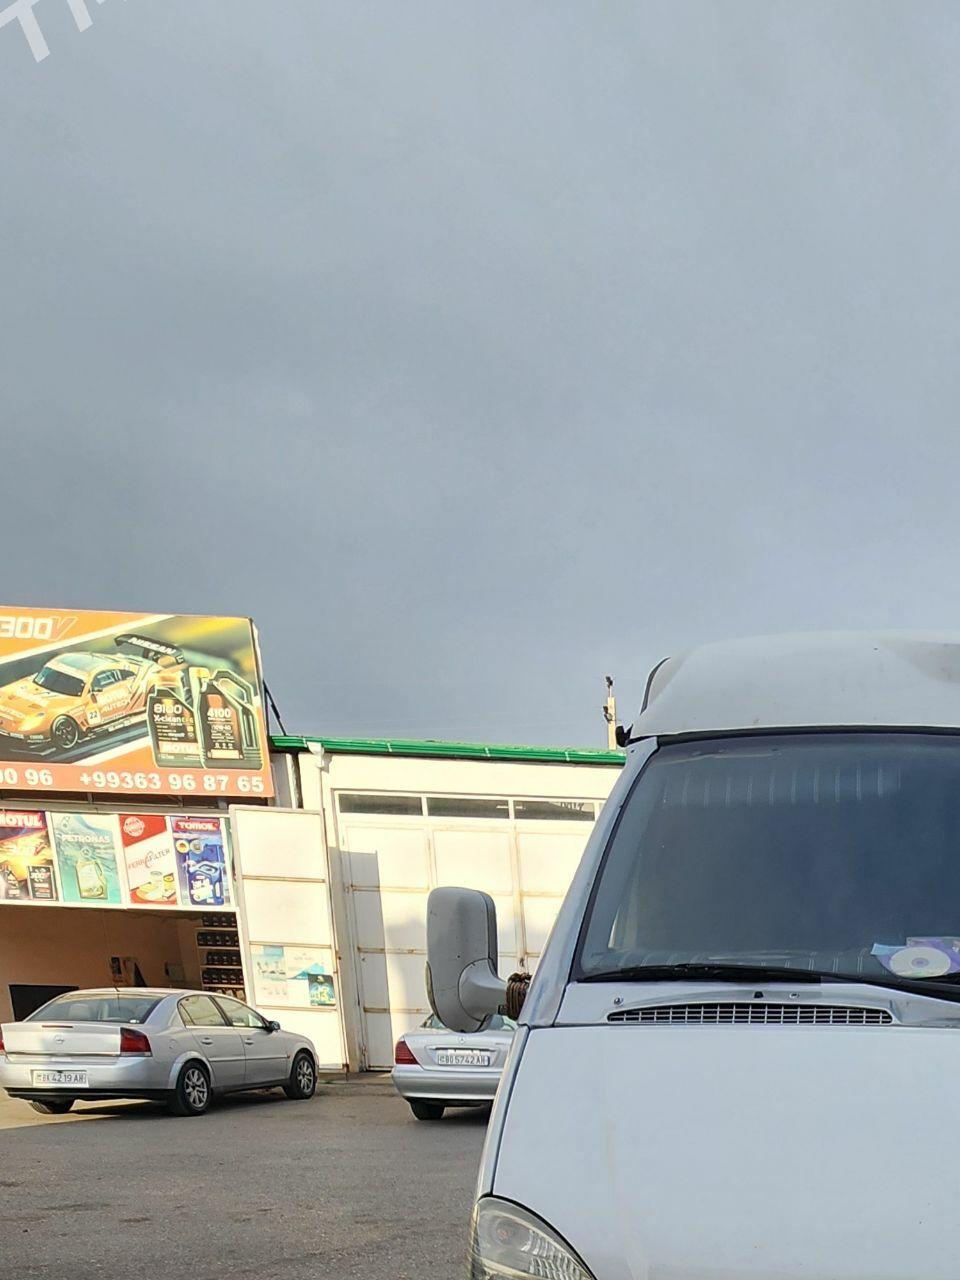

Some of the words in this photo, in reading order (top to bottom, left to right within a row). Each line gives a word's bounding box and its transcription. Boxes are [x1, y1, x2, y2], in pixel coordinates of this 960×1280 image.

[153, 703, 182, 714] 8100
[207, 708, 231, 718] 4100
[90, 711, 98, 720] 22
[24, 768, 53, 786] 96
[80, 771, 161, 789] +99363
[168, 774, 196, 790] 96
[203, 775, 229, 791] 87
[237, 776, 264, 792] 65
